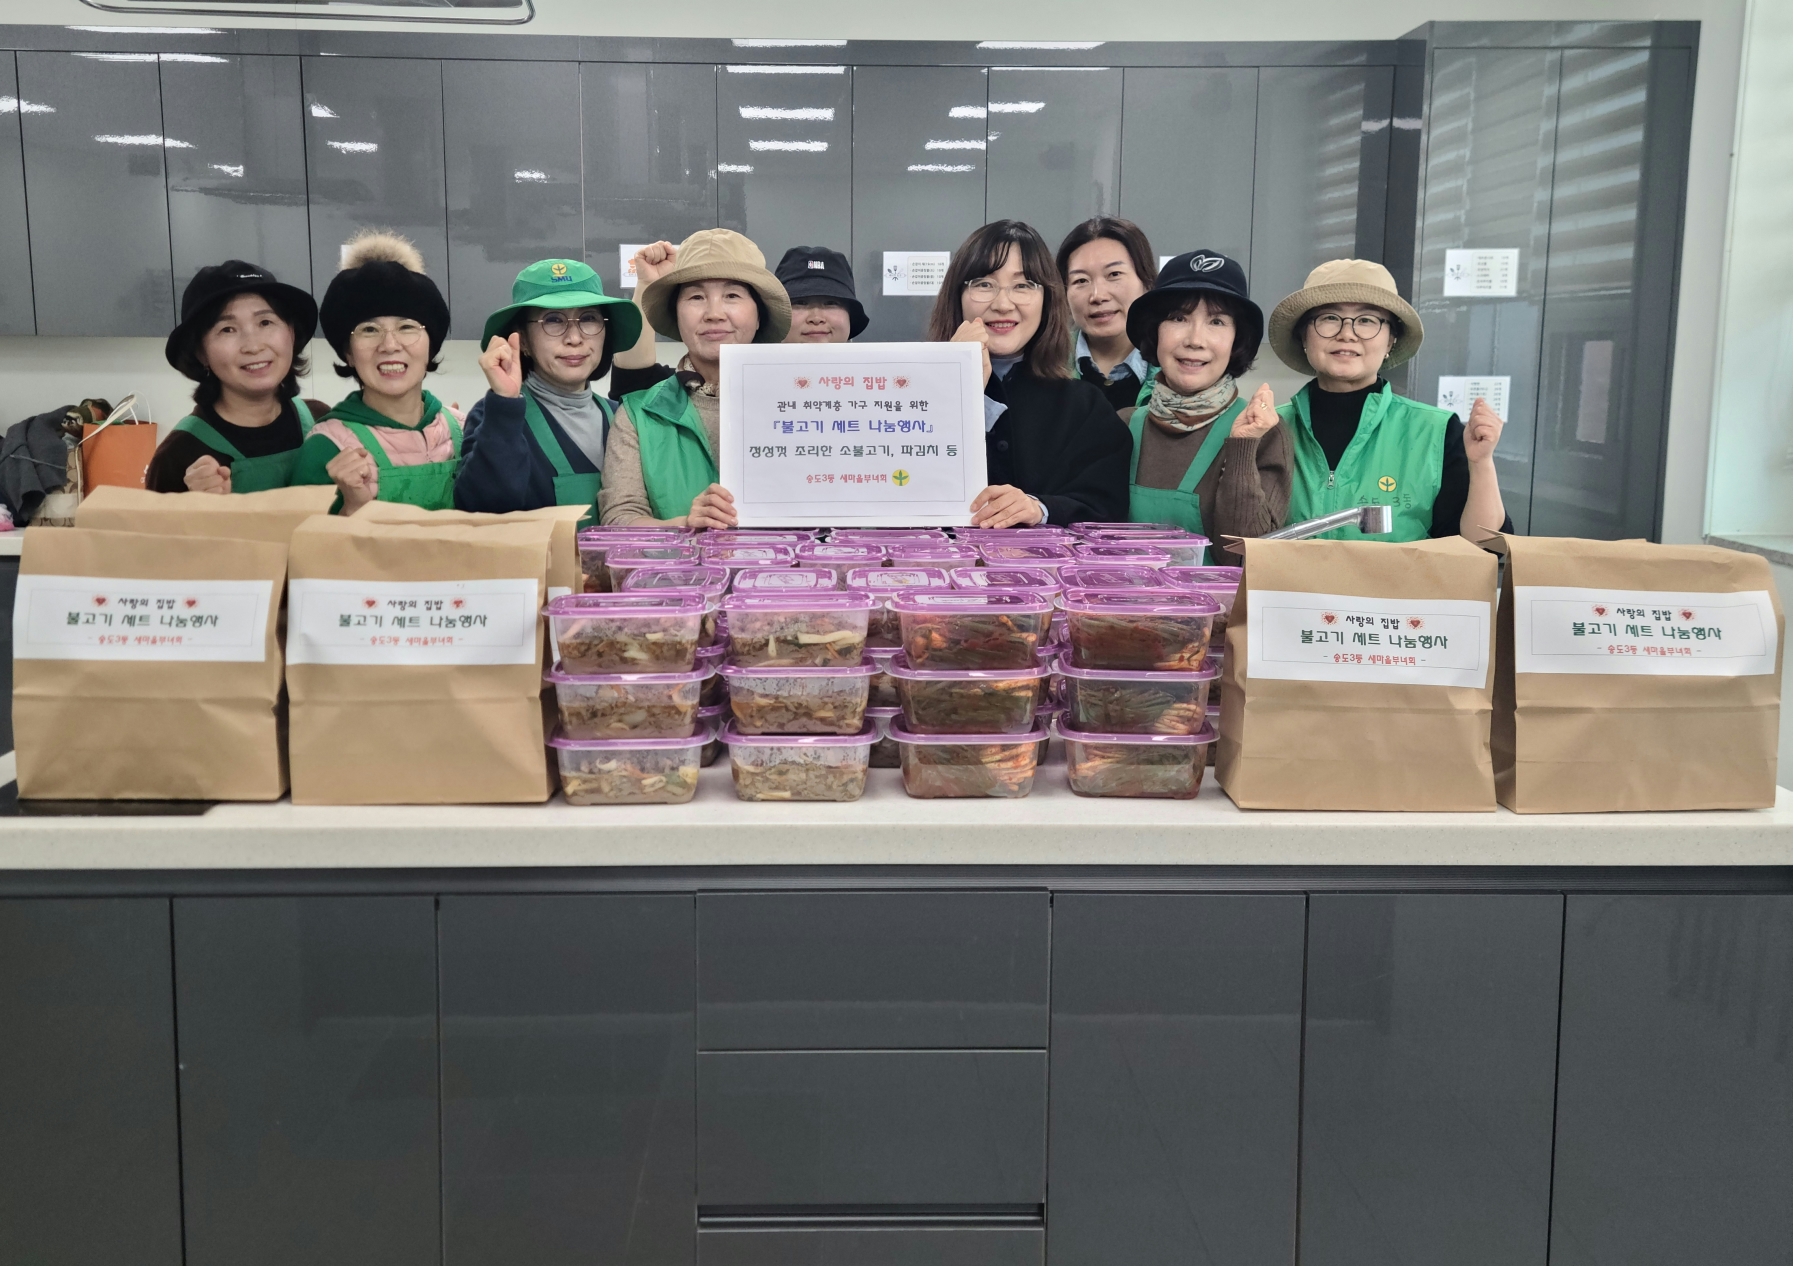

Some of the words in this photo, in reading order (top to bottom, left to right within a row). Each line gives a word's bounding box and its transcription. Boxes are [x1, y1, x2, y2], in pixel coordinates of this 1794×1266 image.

[814, 261, 824, 270] NBA
[551, 275, 573, 283] SMU
[818, 376, 854, 390] 사랑의
[862, 376, 888, 390] 집밥
[777, 401, 796, 412] 관내
[803, 400, 842, 412] 취약계층
[848, 400, 868, 410] 가구
[874, 400, 902, 412] 지원을
[909, 400, 929, 412] 위한
[832, 420, 860, 433] 세트
[749, 445, 787, 458] 정성껏
[794, 444, 832, 457] 조리한
[840, 444, 894, 458] 소불고기,
[901, 444, 939, 456] 파김치
[946, 444, 958, 456] 등
[806, 474, 835, 484] 송도3동
[840, 474, 887, 484] 새마을부녀회
[118, 598, 149, 610] 사랑의
[156, 598, 176, 610] 집밥
[387, 600, 417, 611] 사랑의
[424, 600, 444, 611] 집밥
[66, 612, 112, 627] 불고기
[121, 614, 150, 627] 세트
[160, 614, 218, 628] 나눔행사
[338, 614, 382, 628] 불고기
[391, 616, 420, 628] 세트
[430, 614, 488, 628] 나눔행사
[1616, 608, 1645, 620] 사랑의
[1652, 610, 1672, 621] 집밥
[1346, 615, 1374, 628] 사랑의
[1380, 618, 1400, 630] 집밥
[1572, 622, 1617, 636] 불고기
[1626, 624, 1654, 638] 세트
[1662, 626, 1722, 640] 나눔행사
[1300, 630, 1344, 645] 불고기
[1352, 632, 1381, 646] 세트
[1388, 634, 1448, 649] 나눔행사
[1608, 644, 1638, 654] 송도3동
[1642, 646, 1692, 656] 새마을부녀회
[1334, 653, 1362, 664] 송도3동
[1368, 654, 1416, 665] 새마을부녀회
